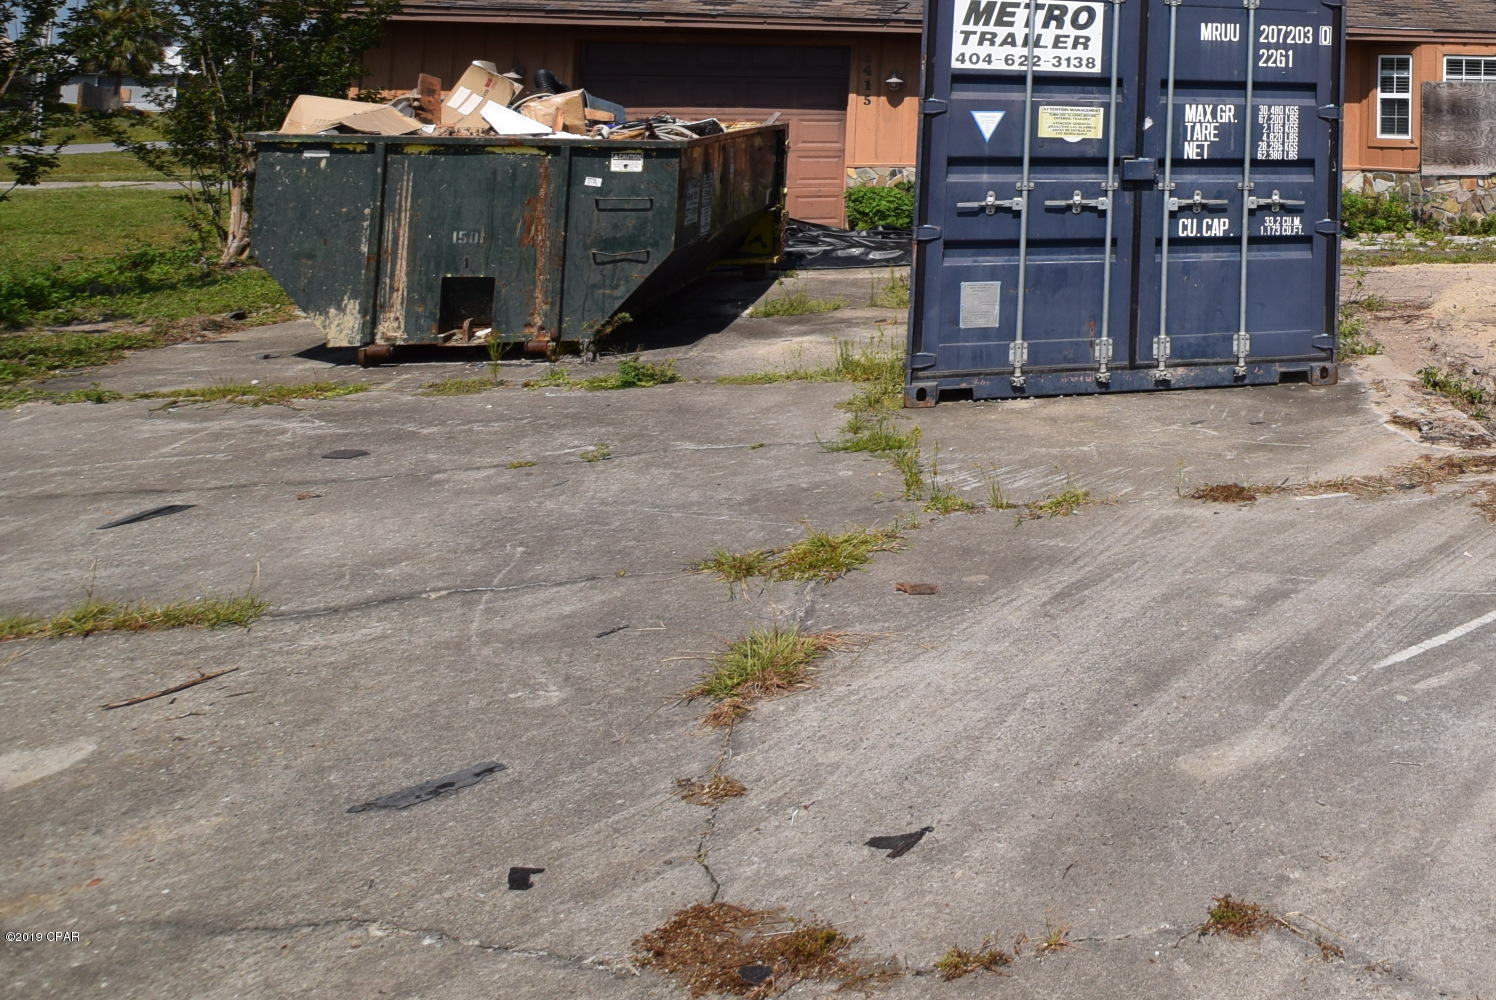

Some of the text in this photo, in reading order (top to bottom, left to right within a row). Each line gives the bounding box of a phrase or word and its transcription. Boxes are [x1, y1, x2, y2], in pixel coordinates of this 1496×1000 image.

[962, 0, 1097, 31] METRO
[959, 30, 1092, 50] TRAILER
[1200, 22, 1331, 45] MRUU 207203 0
[955, 52, 1096, 69] 404-622-3138
[1258, 49, 1293, 68] 22G1
[1184, 104, 1238, 123] MAX.GR.
[1285, 105, 1299, 115] KGS
[1285, 114, 1299, 124] LBS
[1184, 123, 1220, 141] TARE
[1284, 123, 1299, 133] KGS
[1284, 132, 1299, 142] LBS
[1184, 141, 1211, 159] NET
[1284, 141, 1298, 151] KGS
[1284, 150, 1298, 160] LBS
[1260, 225, 1280, 235] 1.173
[1264, 216, 1281, 226] 33.2
